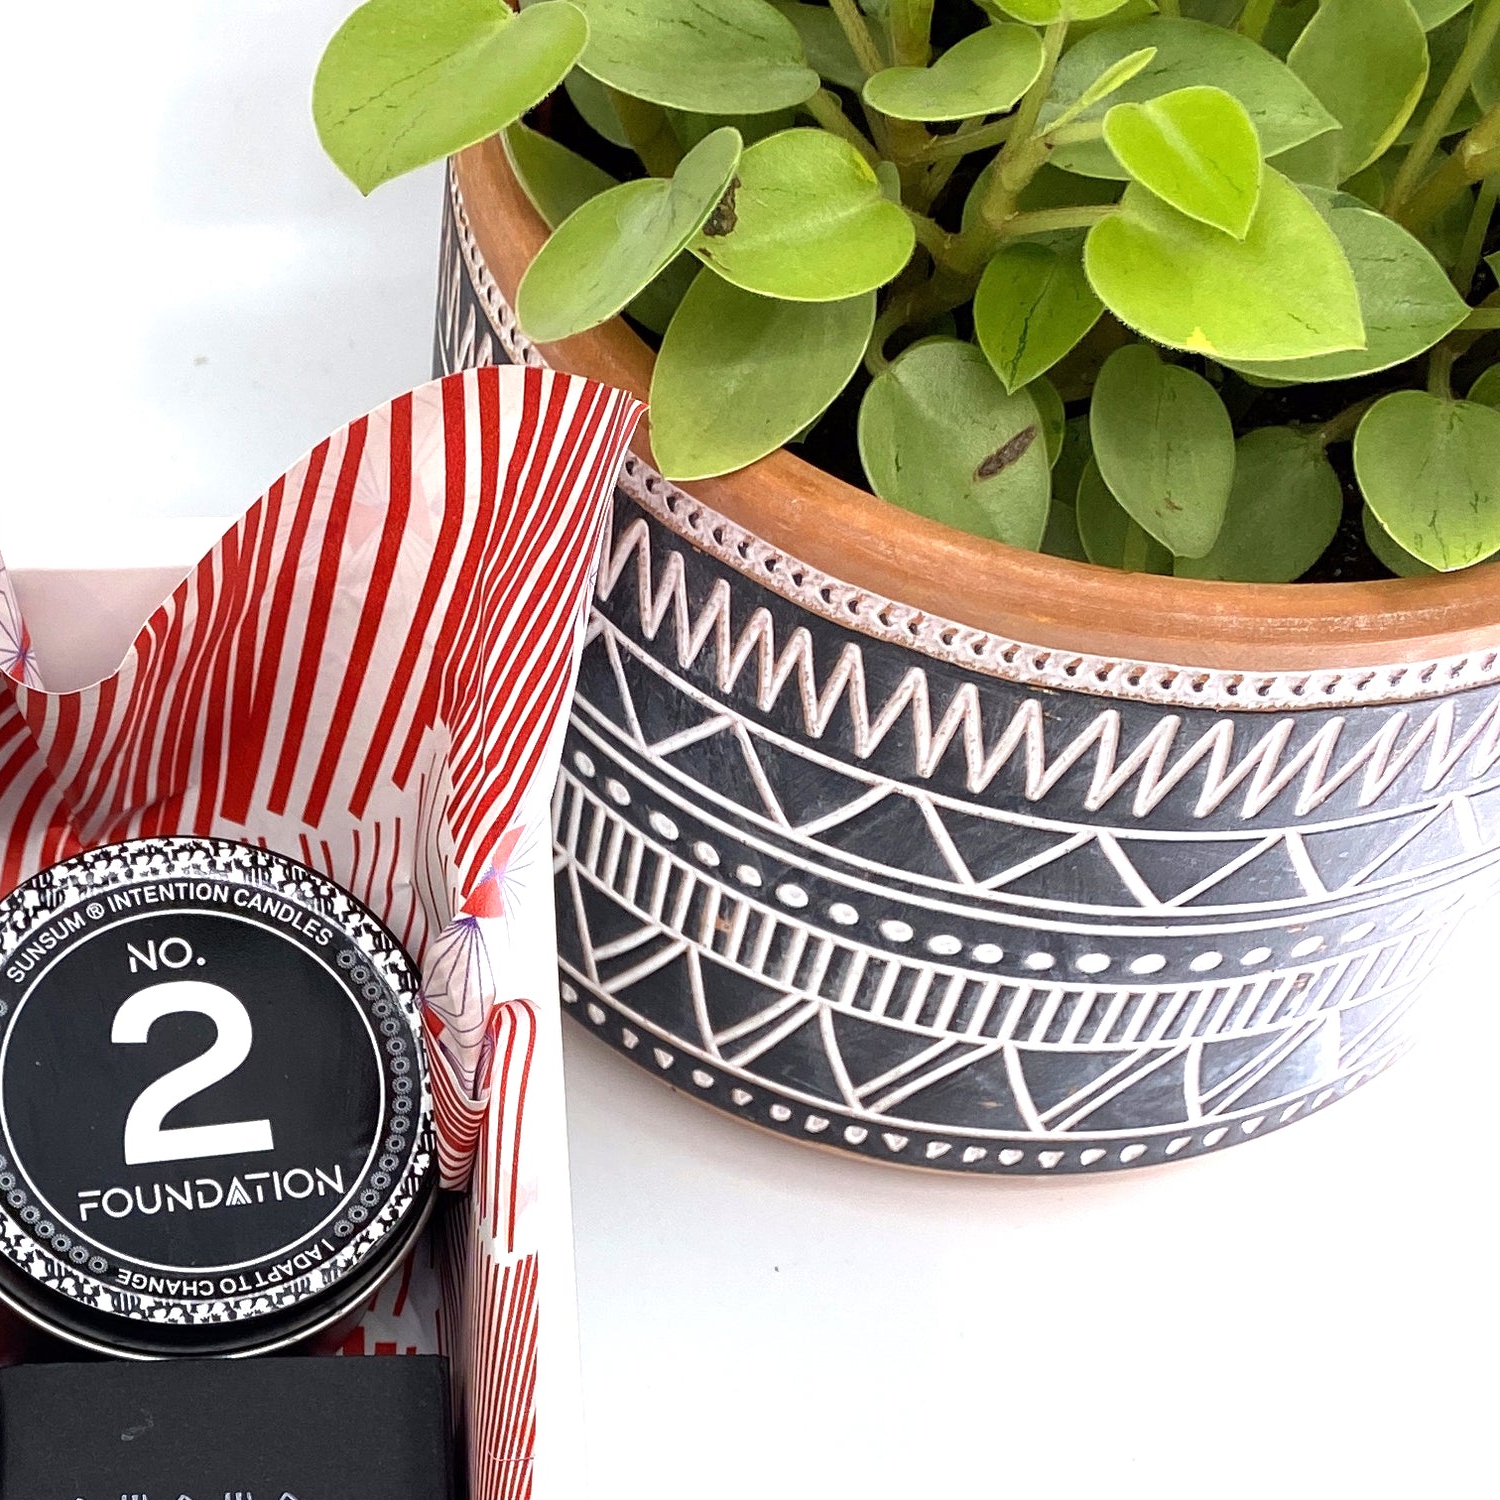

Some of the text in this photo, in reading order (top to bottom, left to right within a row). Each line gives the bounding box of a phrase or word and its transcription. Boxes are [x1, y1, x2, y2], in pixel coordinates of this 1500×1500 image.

[6, 917, 86, 983] SUNSUM
[107, 882, 228, 912] INTENTION
[233, 889, 334, 946] CANDLES
[128, 937, 206, 973] NO.
[111, 981, 274, 1165] 2
[78, 1165, 345, 1221] FOUNDATION
[116, 1268, 214, 1297] CHANGE
[220, 1276, 252, 1294] TO
[255, 1243, 323, 1288] ADAPT
